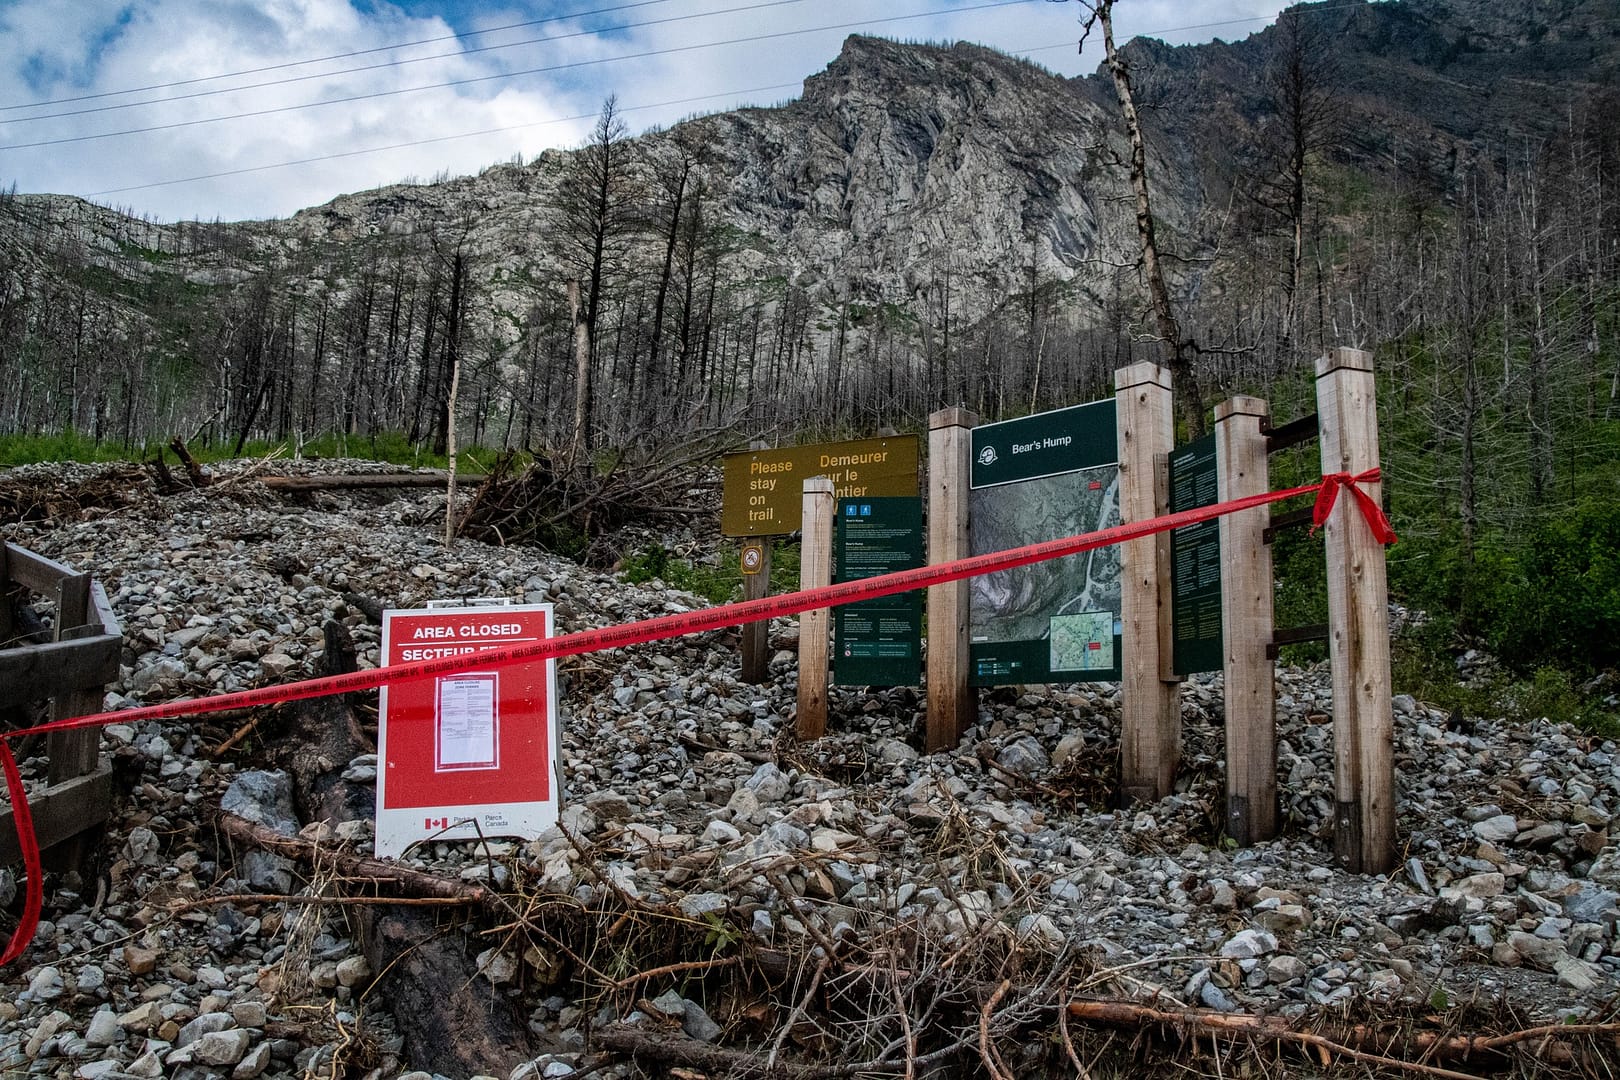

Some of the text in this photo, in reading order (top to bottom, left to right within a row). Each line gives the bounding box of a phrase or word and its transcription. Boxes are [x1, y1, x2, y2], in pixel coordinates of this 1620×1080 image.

[1012, 435, 1072, 455] Bear's Hump
[820, 451, 888, 468] Demeurer
[751, 460, 793, 474] Please
[846, 469, 858, 481] le
[750, 479, 776, 491] stay
[836, 484, 868, 498] ntier
[750, 494, 766, 506] on
[750, 508, 774, 521] trail
[414, 624, 522, 639] AREA CLOSED
